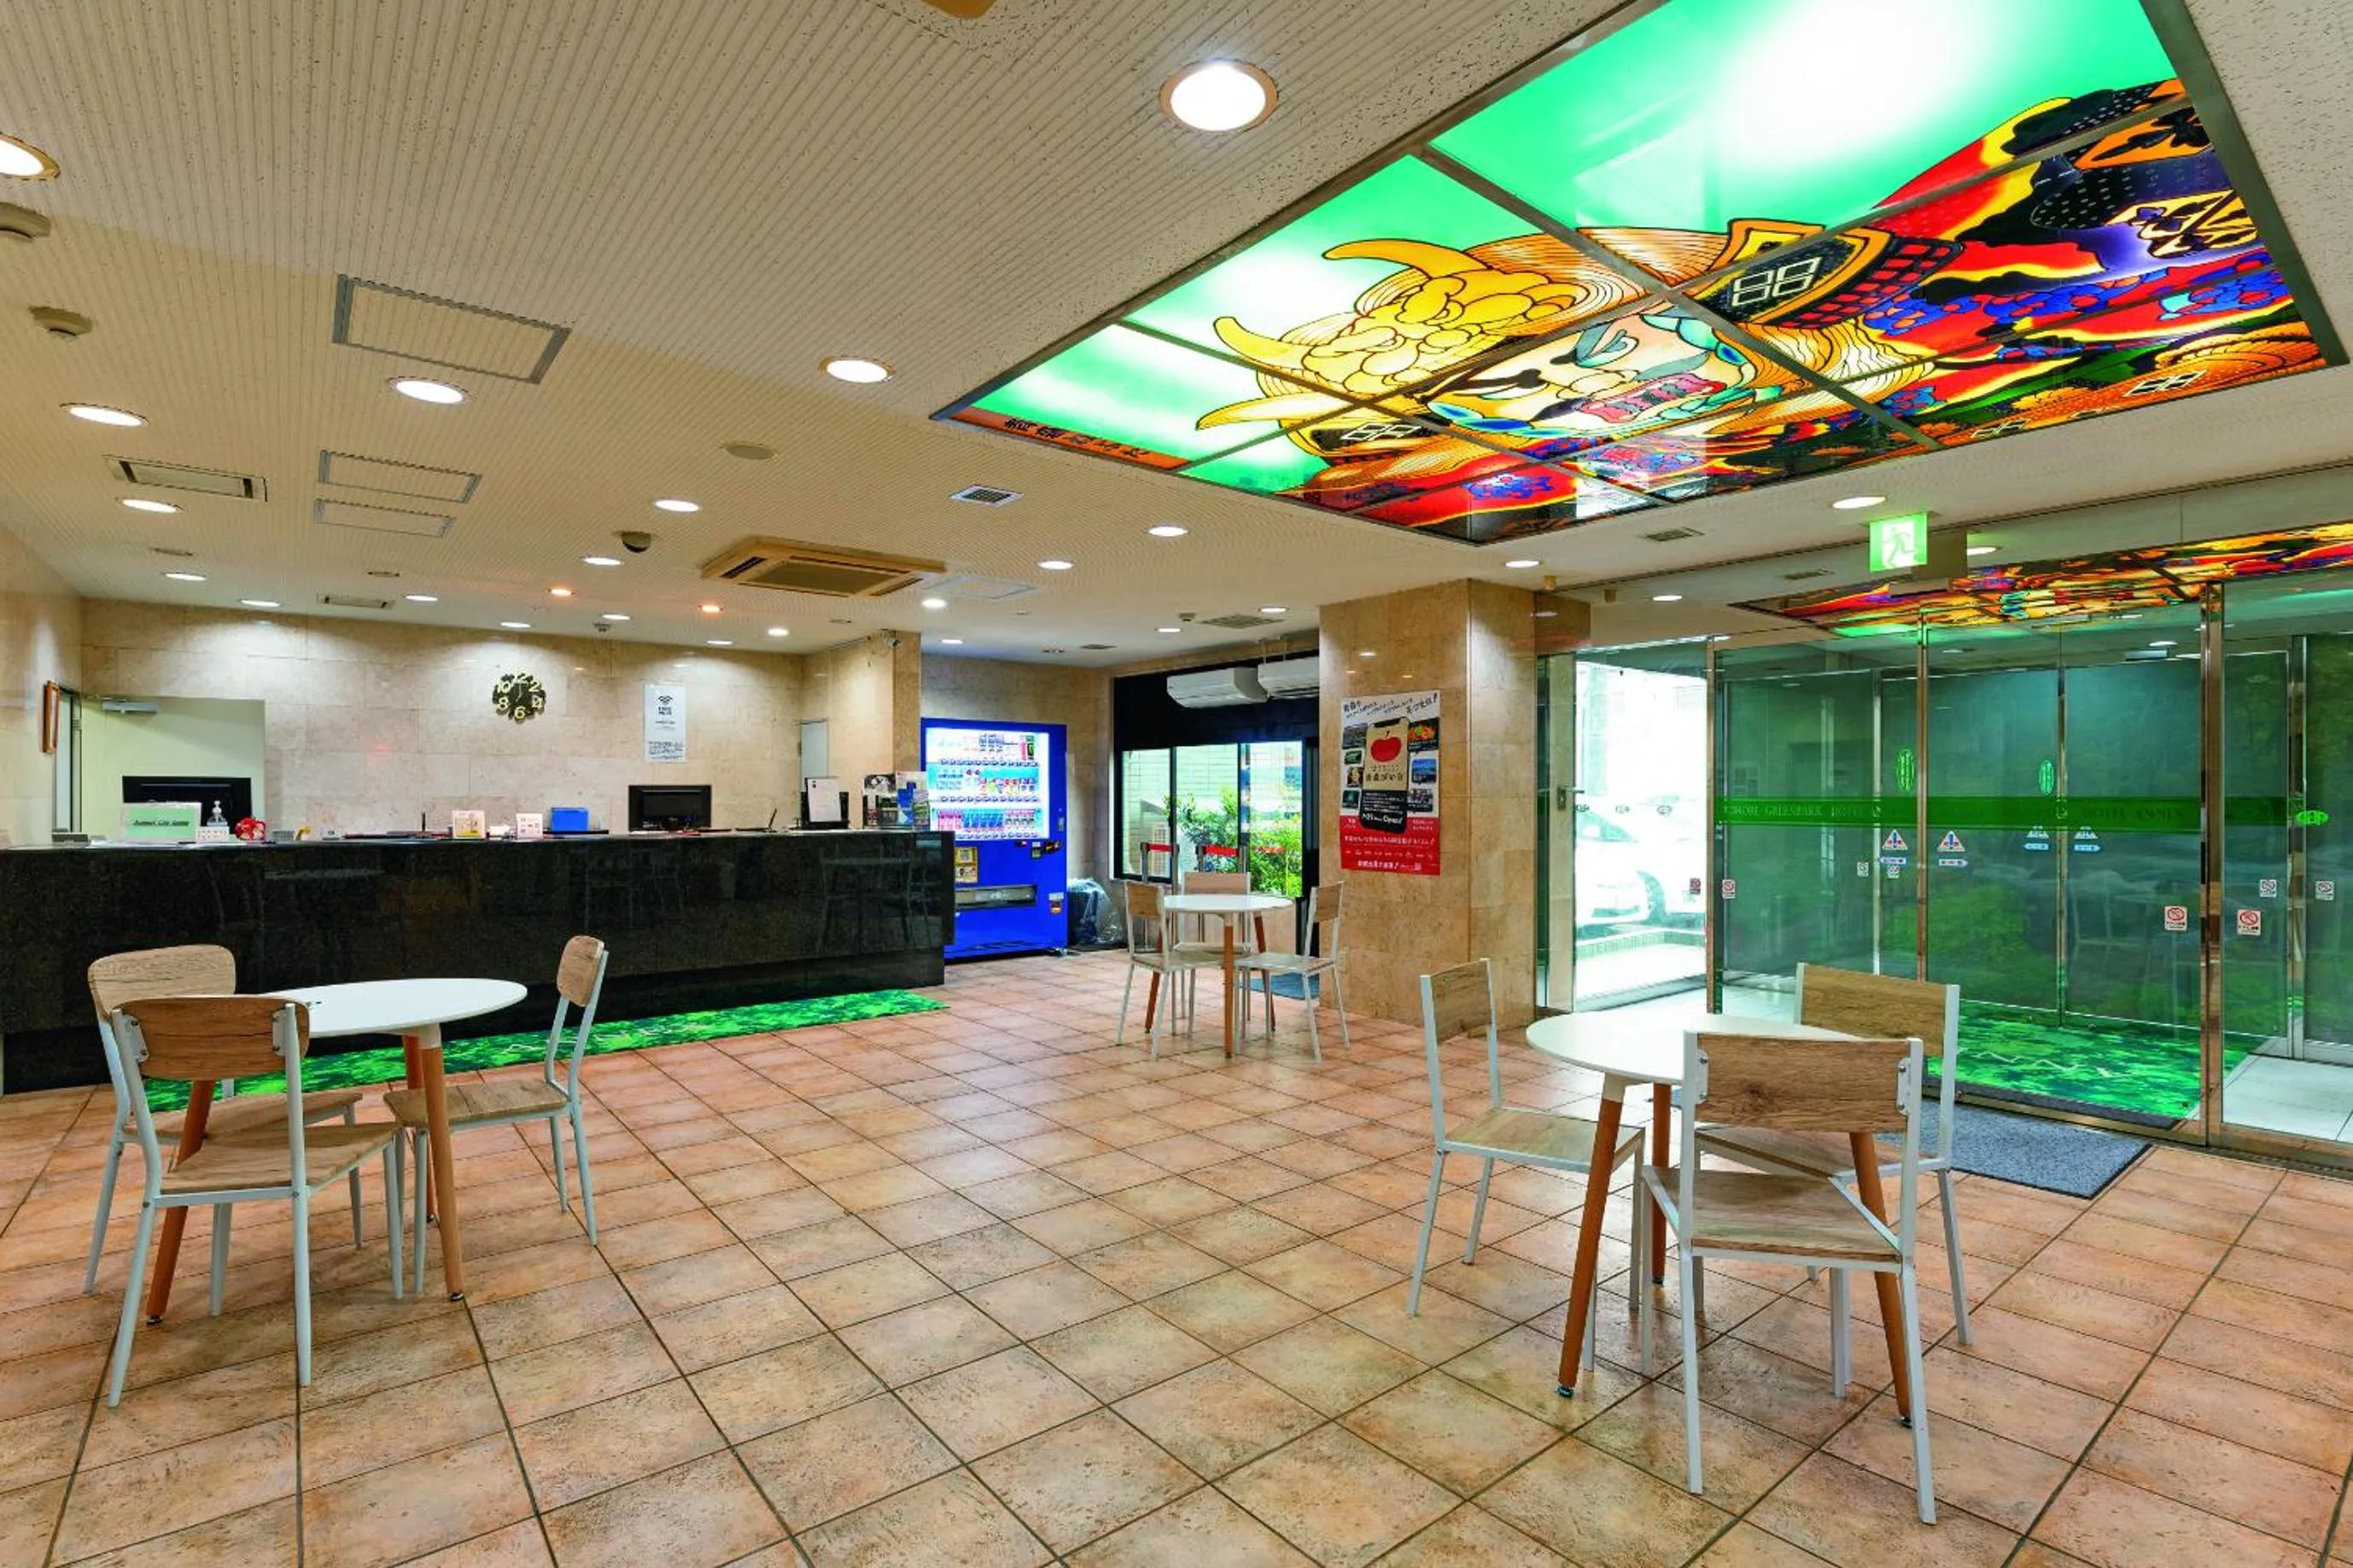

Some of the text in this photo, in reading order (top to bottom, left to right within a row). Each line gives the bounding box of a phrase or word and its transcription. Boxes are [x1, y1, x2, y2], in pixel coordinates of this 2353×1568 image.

[496, 681, 511, 693] 10
[528, 679, 540, 692] 2
[498, 697, 509, 710] 8
[514, 706, 526, 719] 6
